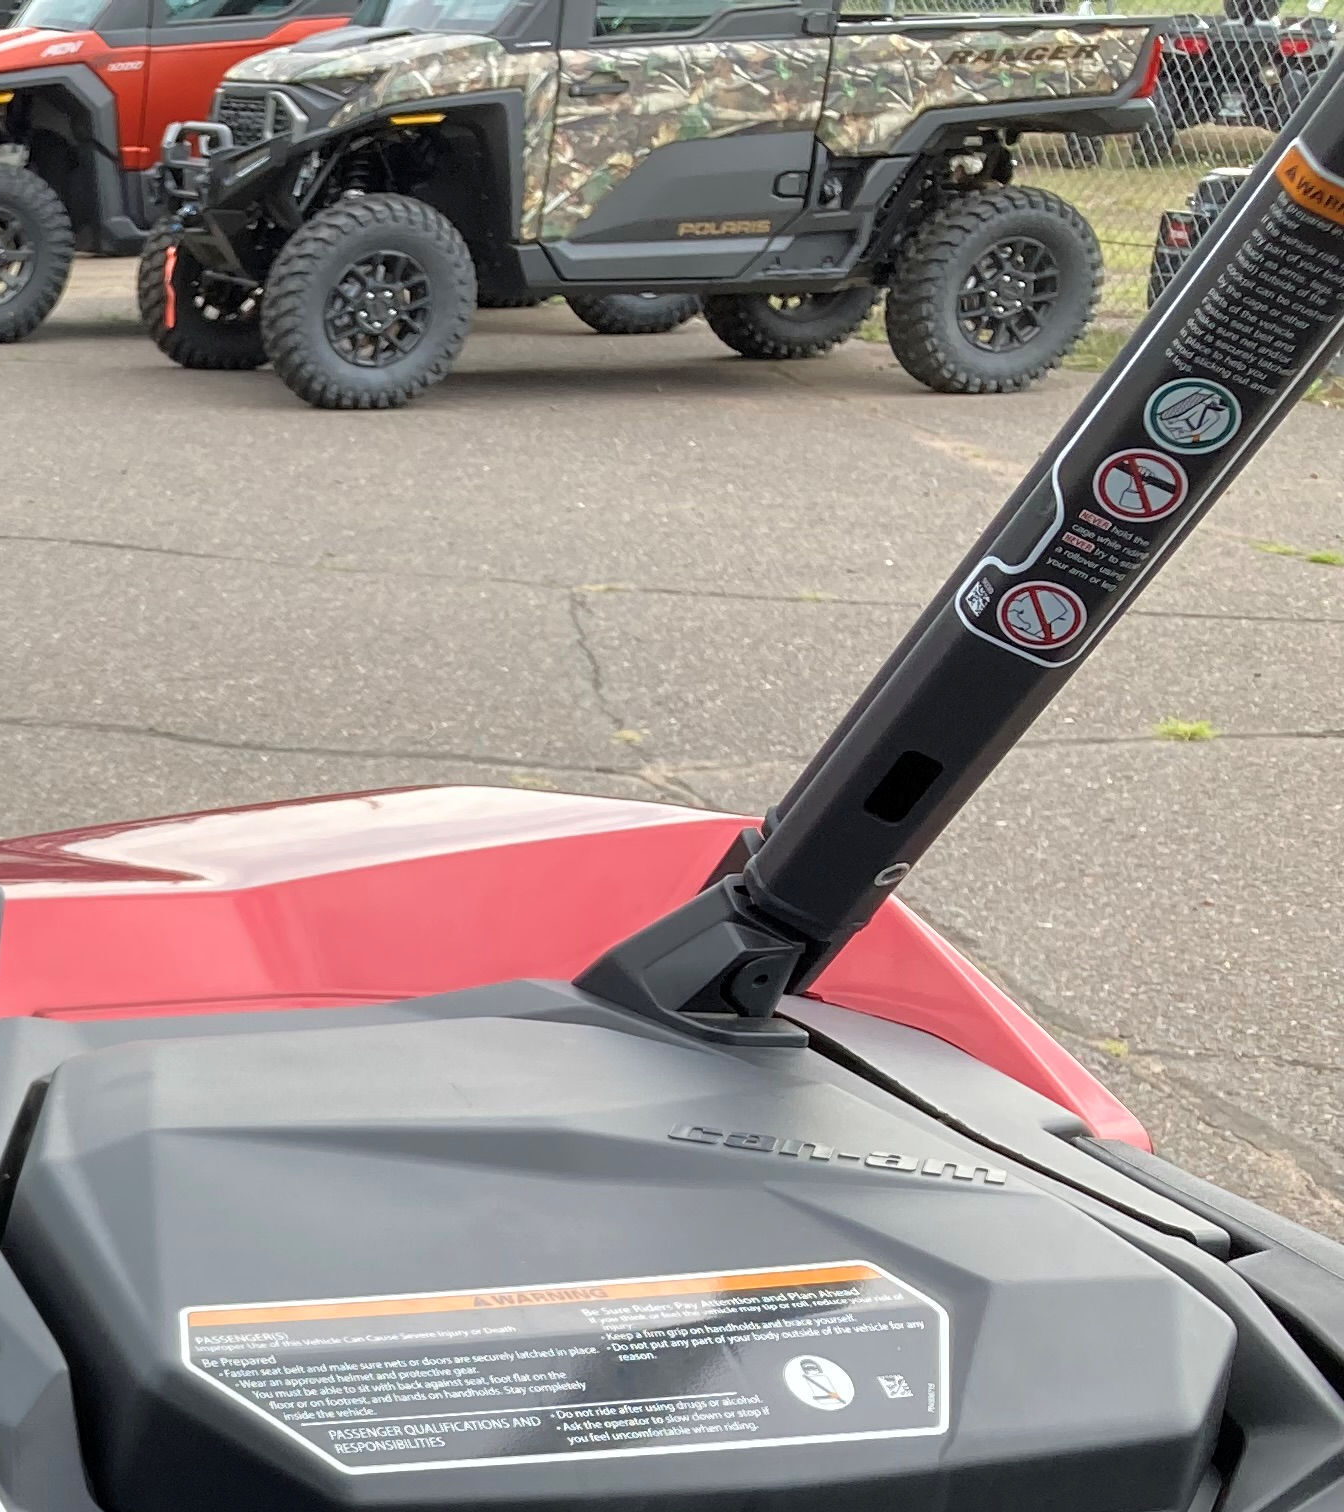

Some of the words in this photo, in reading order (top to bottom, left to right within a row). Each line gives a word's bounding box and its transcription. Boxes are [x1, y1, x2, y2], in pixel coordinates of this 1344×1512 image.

[677, 219, 772, 237] POLARIS
[667, 1123, 1008, 1185] can-am
[493, 1288, 610, 1306] WARNING
[194, 1331, 288, 1344] PASSENGER(S)
[200, 1358, 218, 1368] Be
[219, 1354, 276, 1368] Prepared
[327, 1425, 403, 1440] PASSENGER
[403, 1417, 510, 1435] QUALIFICATIONS
[512, 1416, 541, 1427] AND
[334, 1436, 445, 1453] RESPONSIBILITIES
